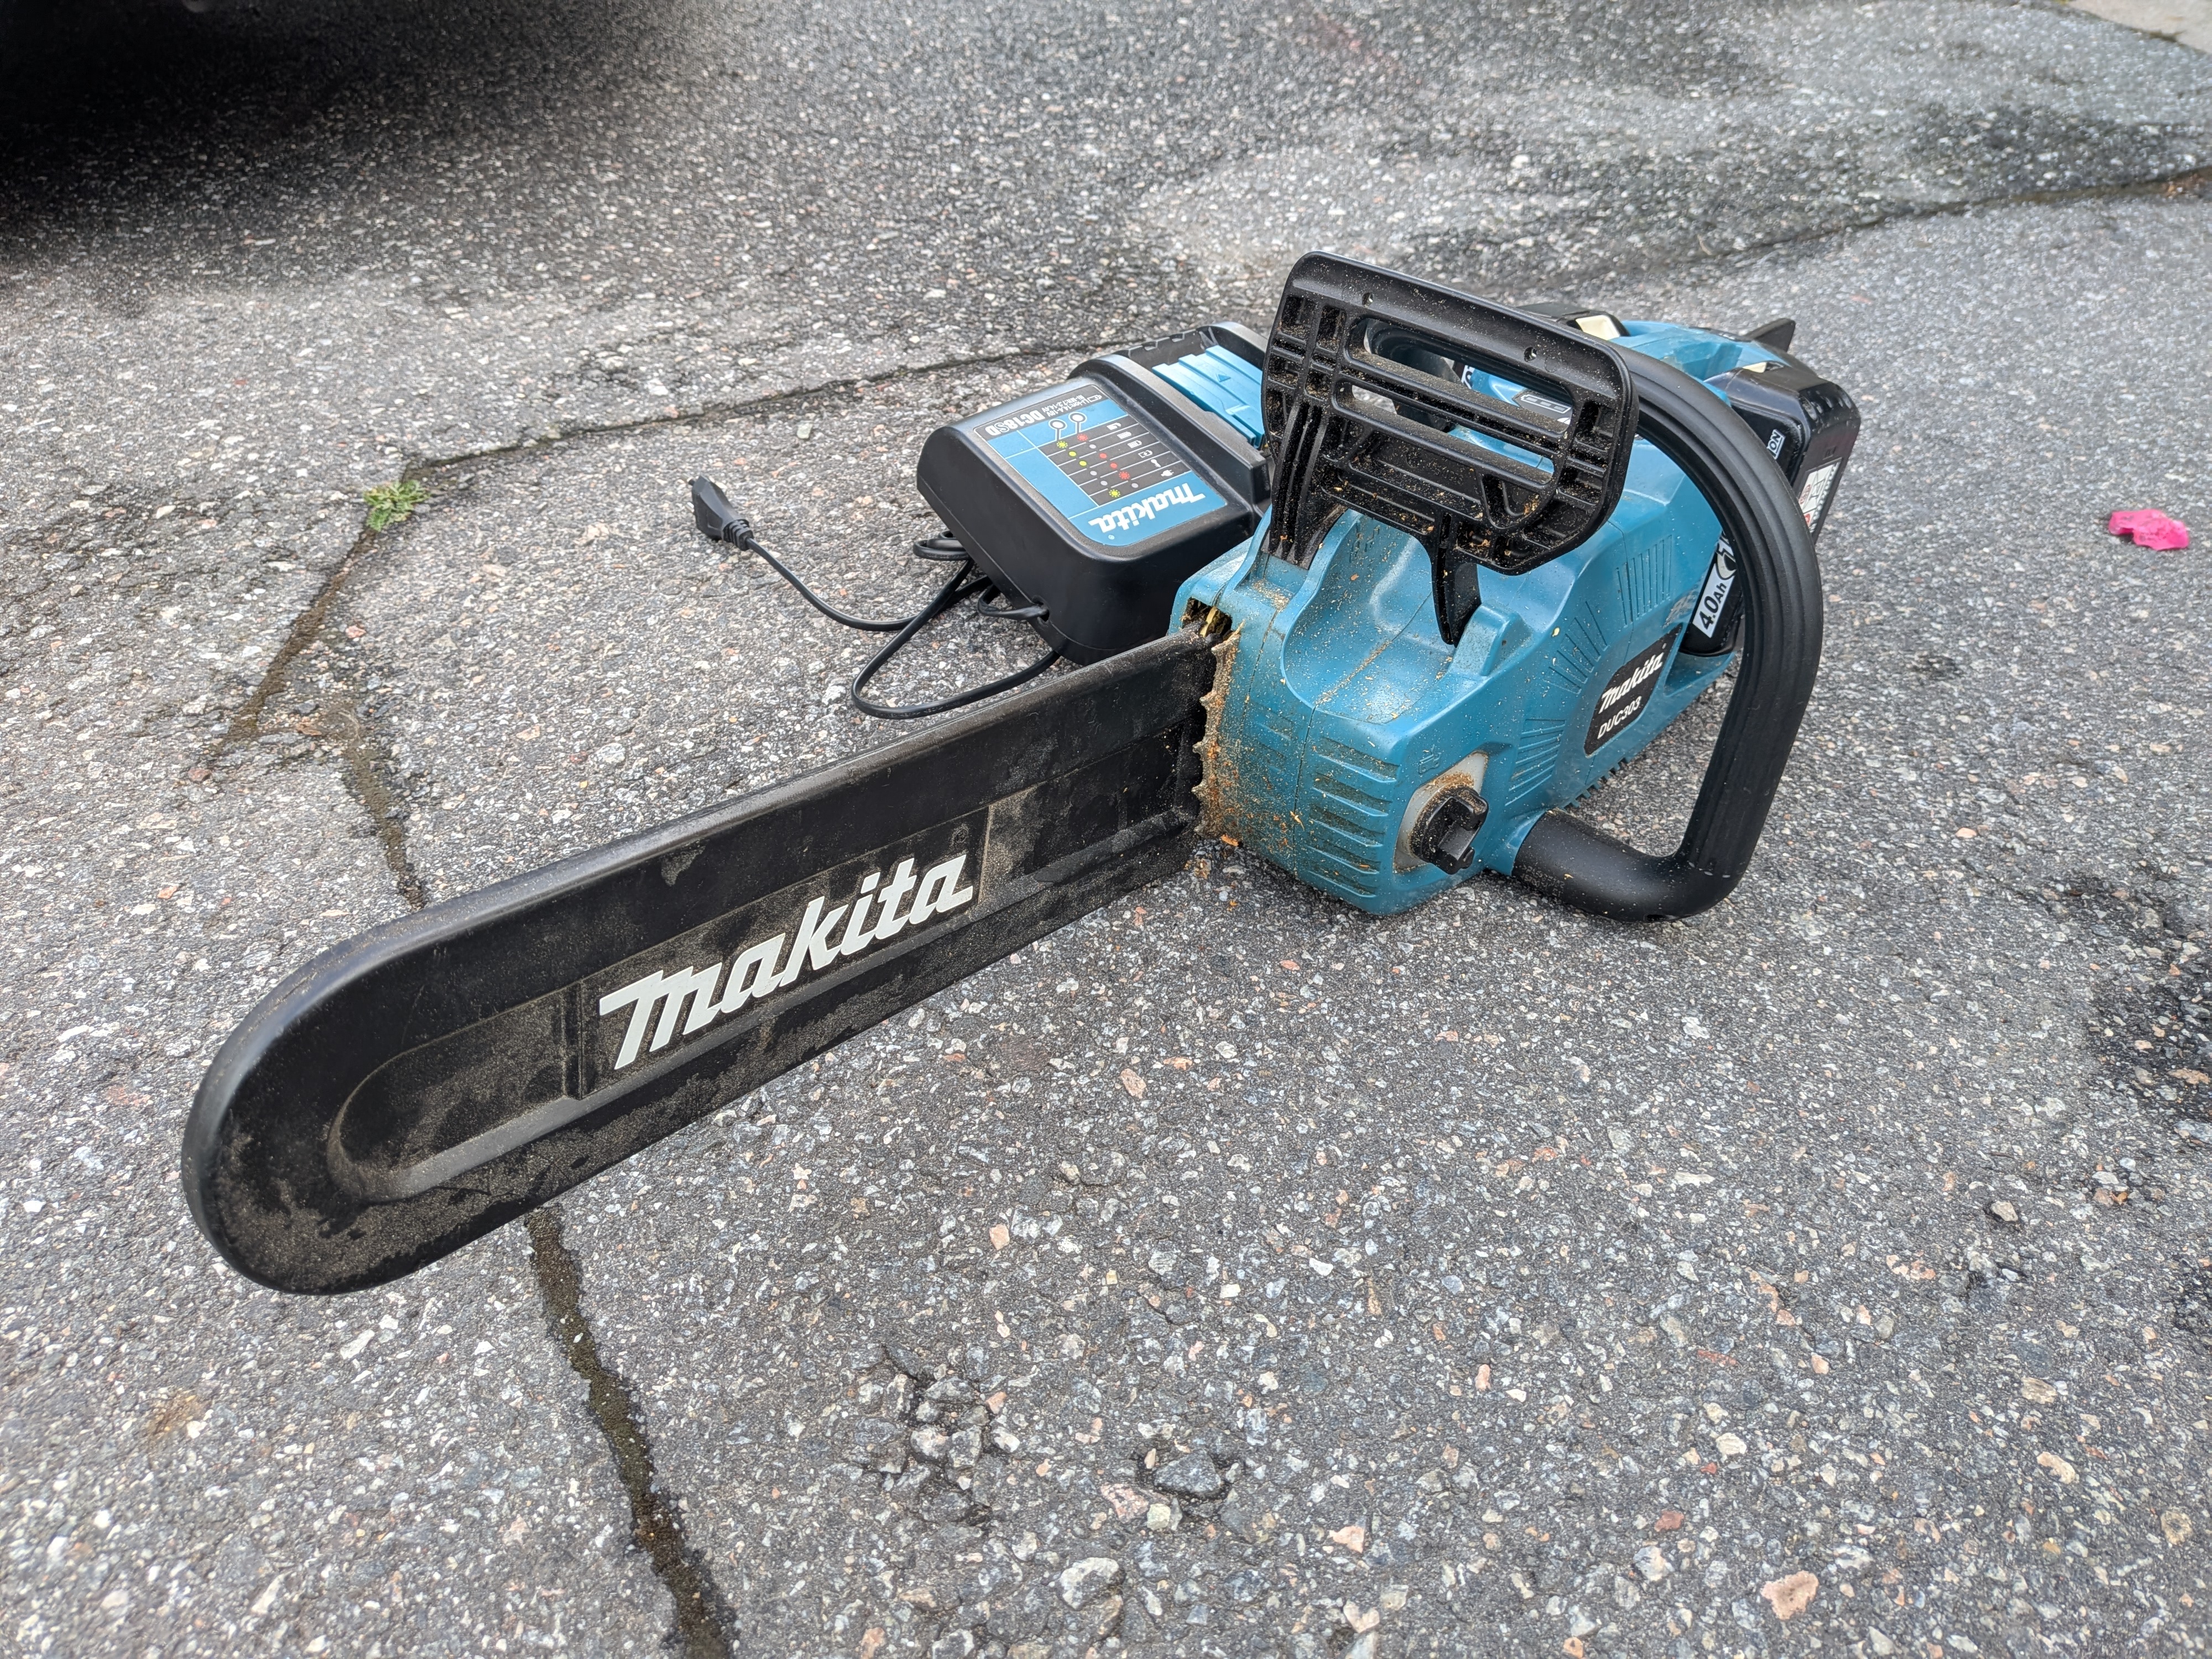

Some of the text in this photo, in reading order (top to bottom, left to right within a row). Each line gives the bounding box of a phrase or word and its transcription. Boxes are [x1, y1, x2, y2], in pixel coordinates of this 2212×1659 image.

[985, 410, 1045, 436] DC18SD
[1699, 582, 1727, 629] 4.0Ah
[1597, 696, 1642, 739] DUC303
